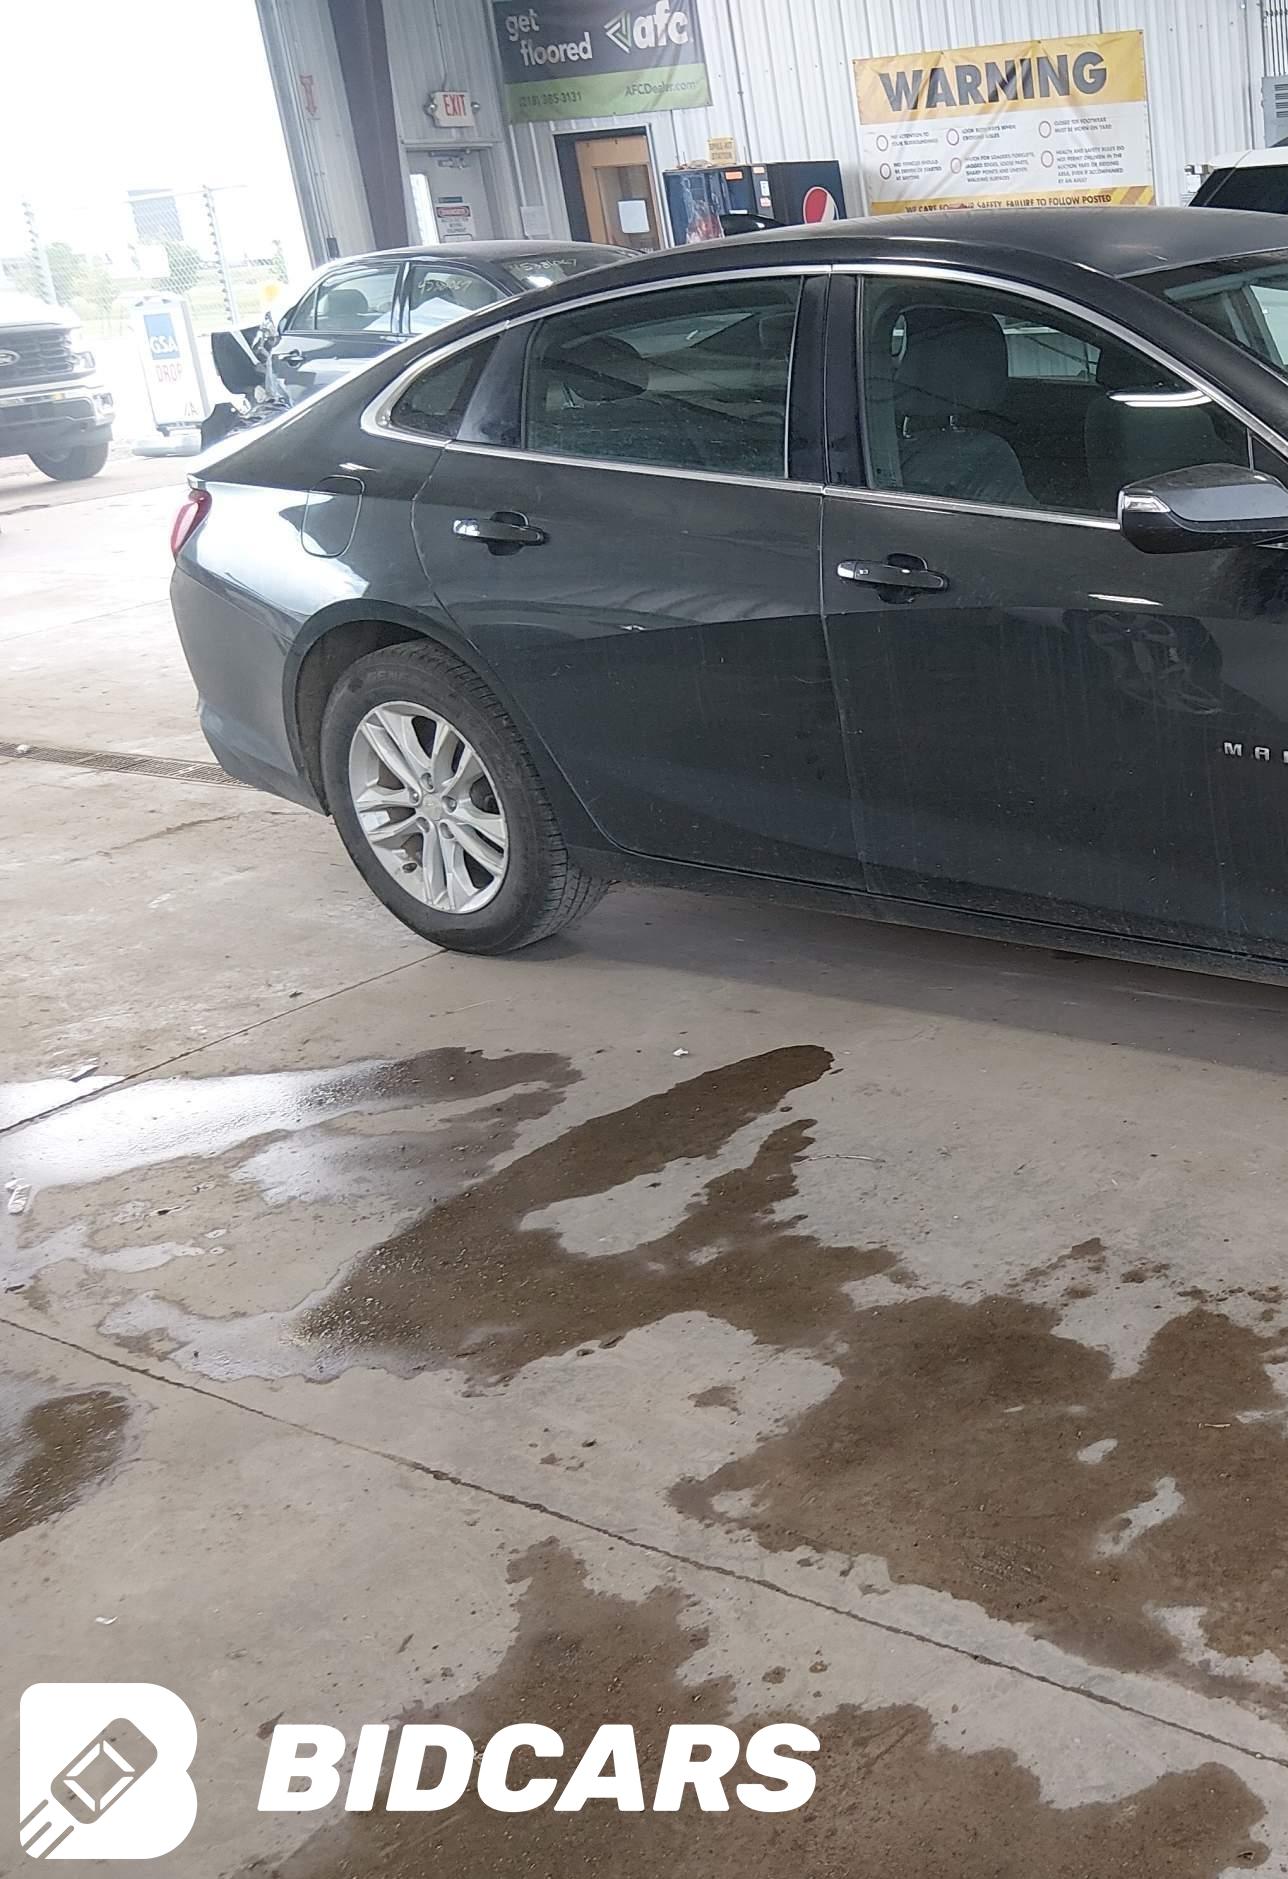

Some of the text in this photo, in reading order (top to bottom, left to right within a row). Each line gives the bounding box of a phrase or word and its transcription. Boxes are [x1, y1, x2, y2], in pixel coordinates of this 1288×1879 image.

[505, 9, 540, 41] get
[633, 0, 689, 49] afc
[520, 32, 593, 66] floored
[625, 80, 697, 97] AFCDealer.com
[879, 51, 1107, 112] WARNING
[443, 94, 467, 117] EXIT
[1036, 198, 1047, 206] TO
[1049, 196, 1080, 205] FOLLOW
[1082, 194, 1112, 204] POSTED
